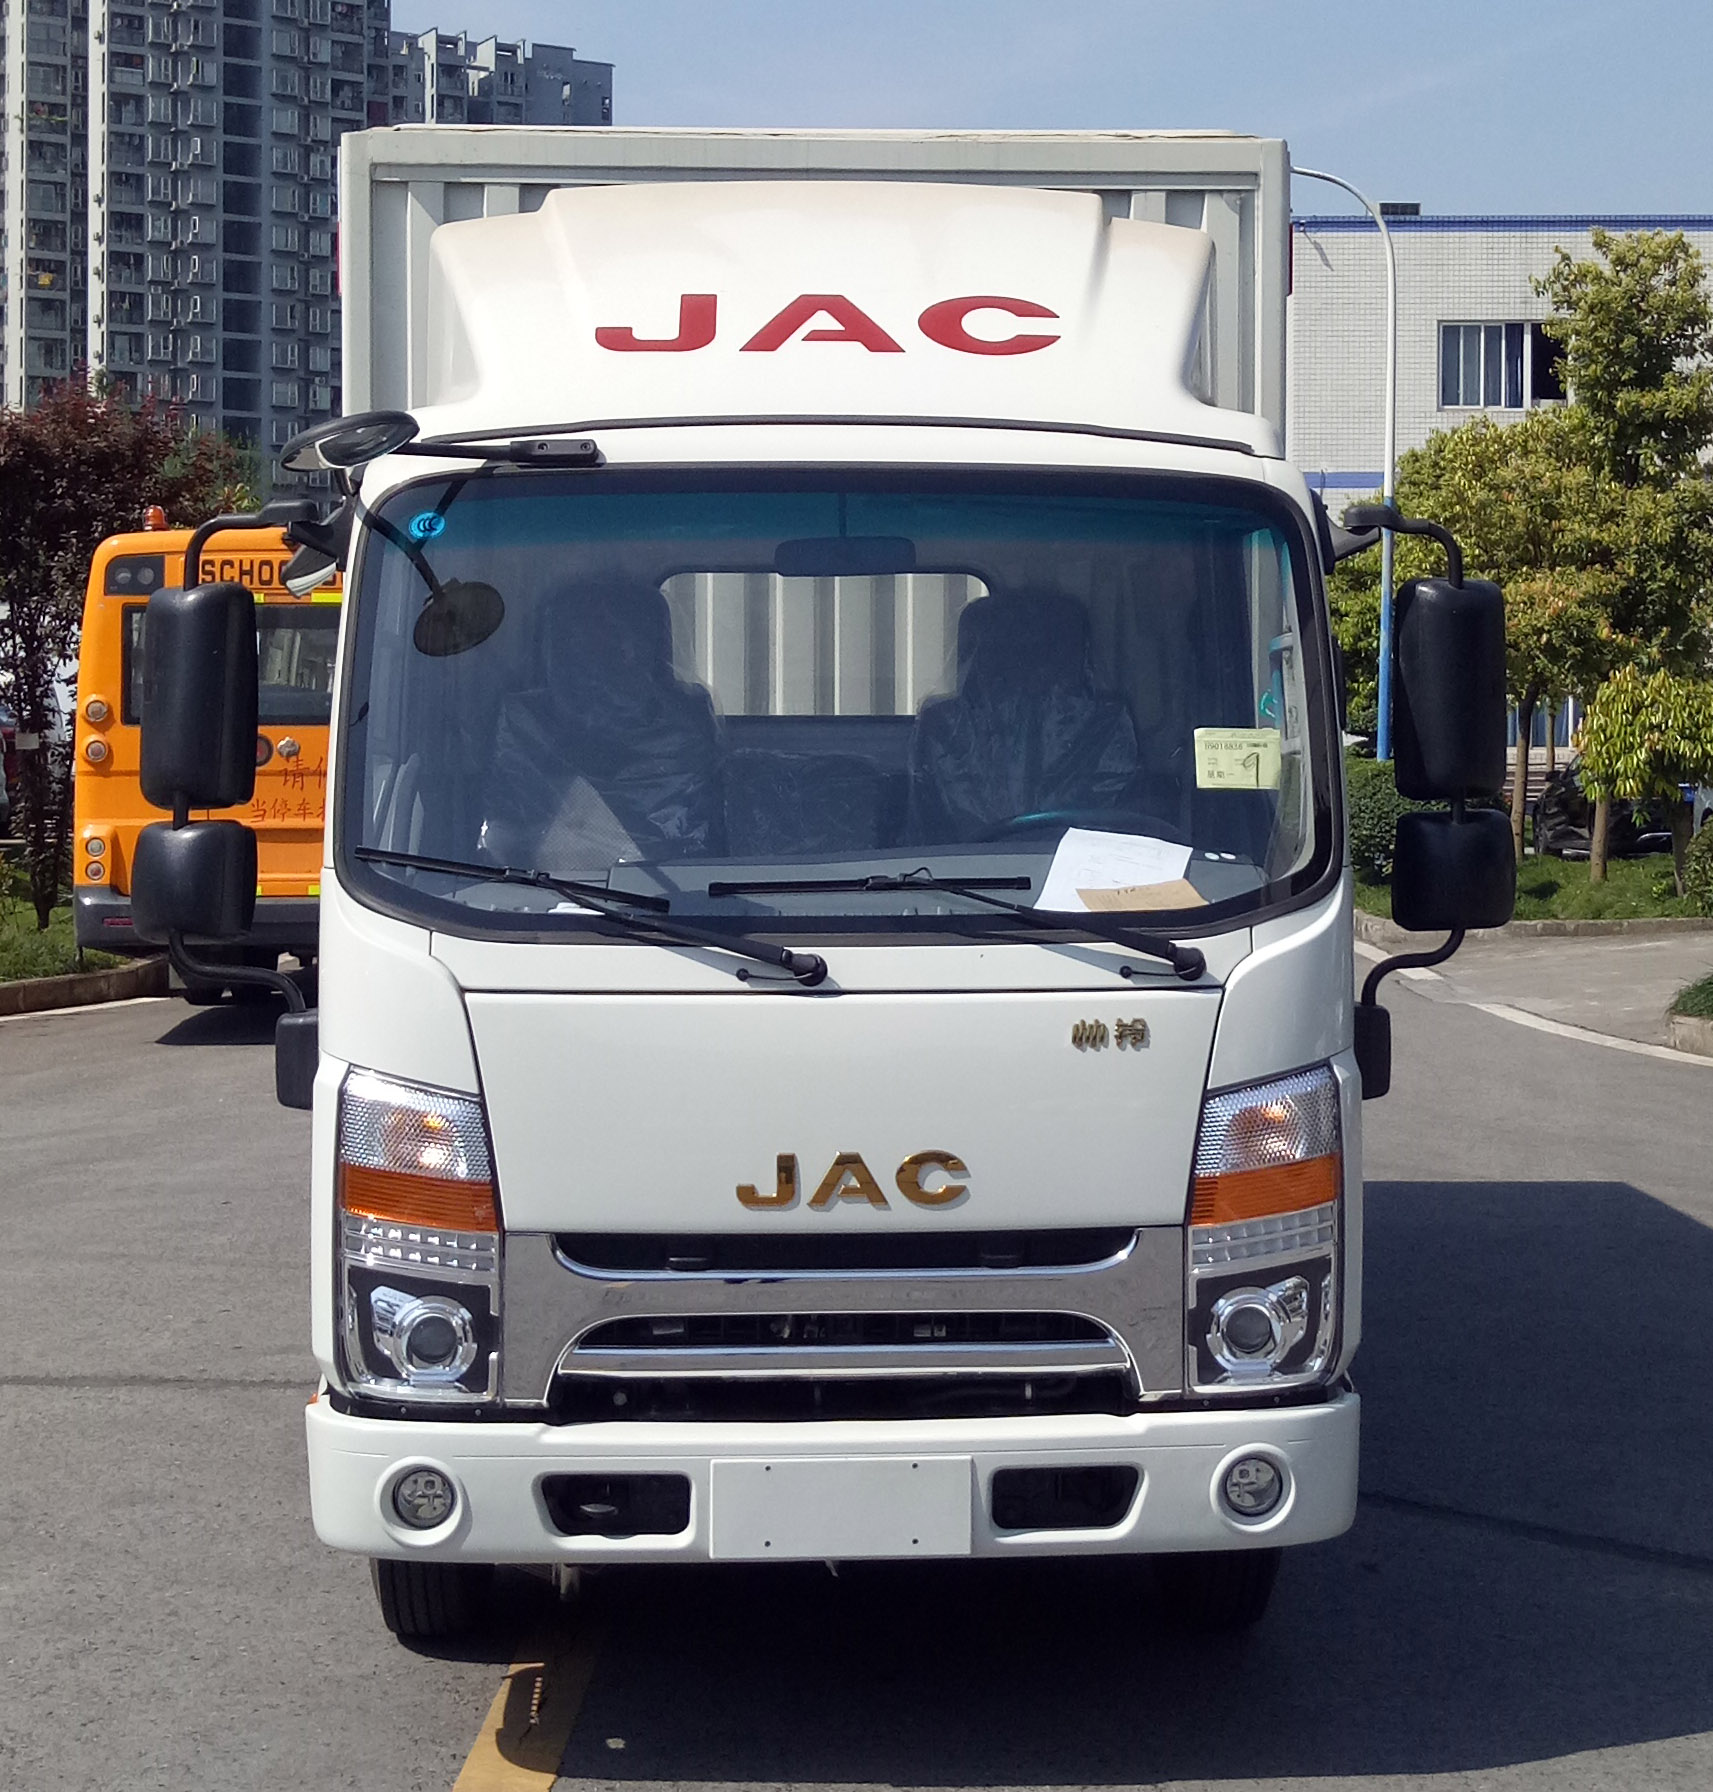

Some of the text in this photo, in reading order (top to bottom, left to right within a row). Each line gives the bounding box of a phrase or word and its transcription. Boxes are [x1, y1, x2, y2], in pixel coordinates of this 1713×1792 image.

[595, 293, 1061, 355] JAC
[200, 559, 294, 586] SCHO
[736, 1150, 971, 1208] JAC
